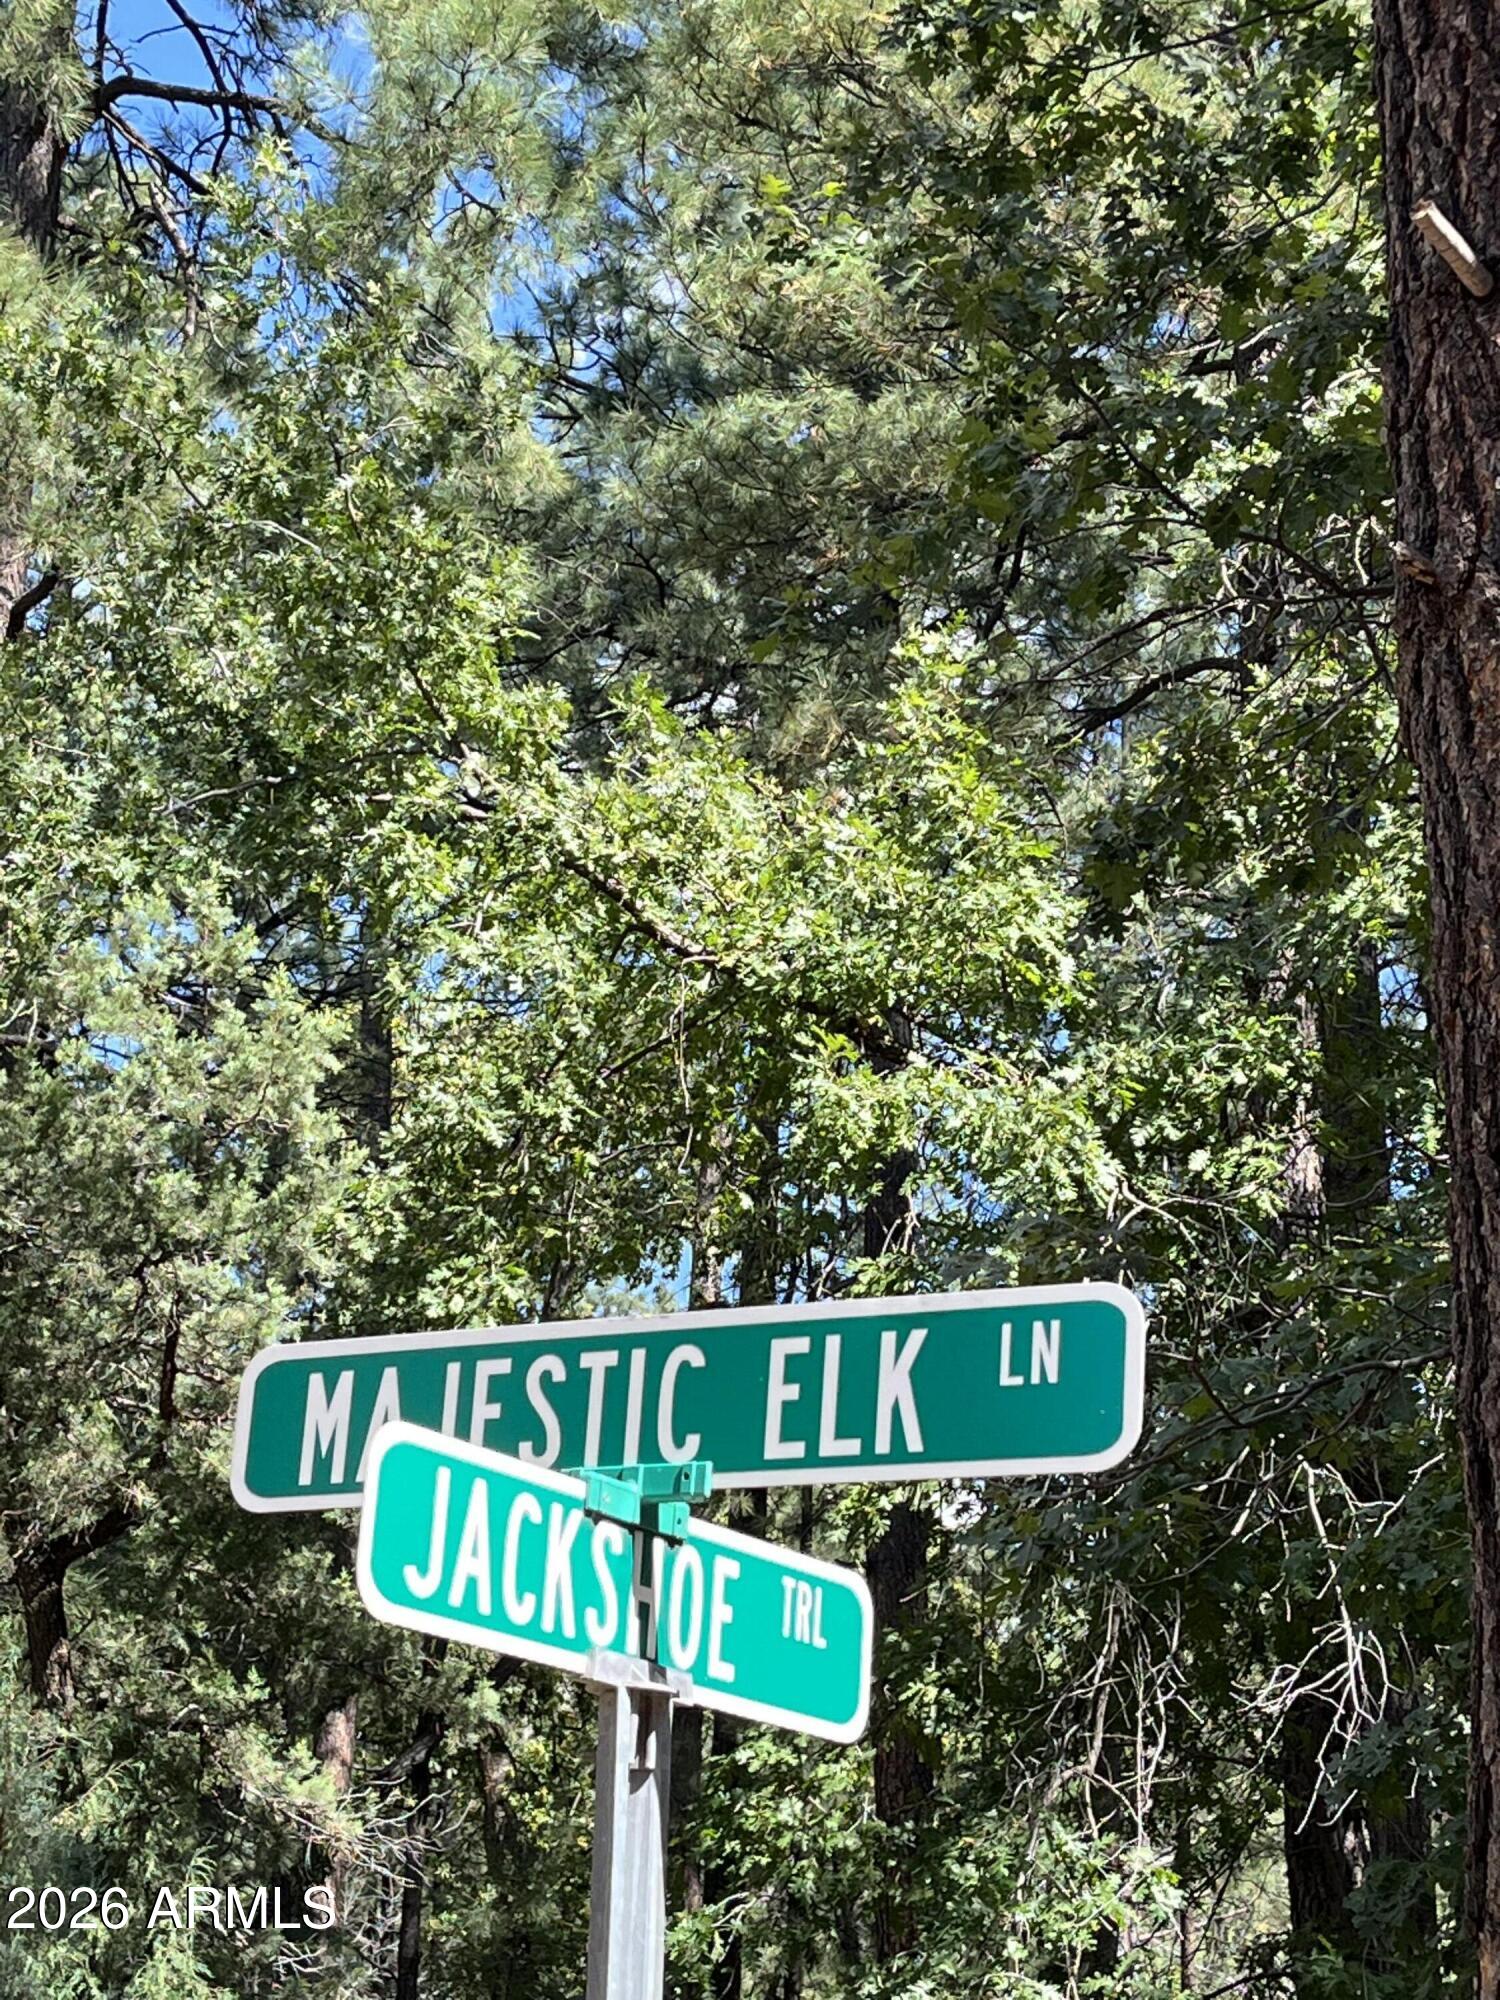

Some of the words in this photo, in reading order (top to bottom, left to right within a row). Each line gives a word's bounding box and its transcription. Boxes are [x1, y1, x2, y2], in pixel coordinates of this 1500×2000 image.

[763, 1328, 929, 1460] ELK
[999, 1319, 1061, 1386] LN
[403, 1465, 741, 1684] JACKSHOE
[781, 1575, 828, 1649] TRL
